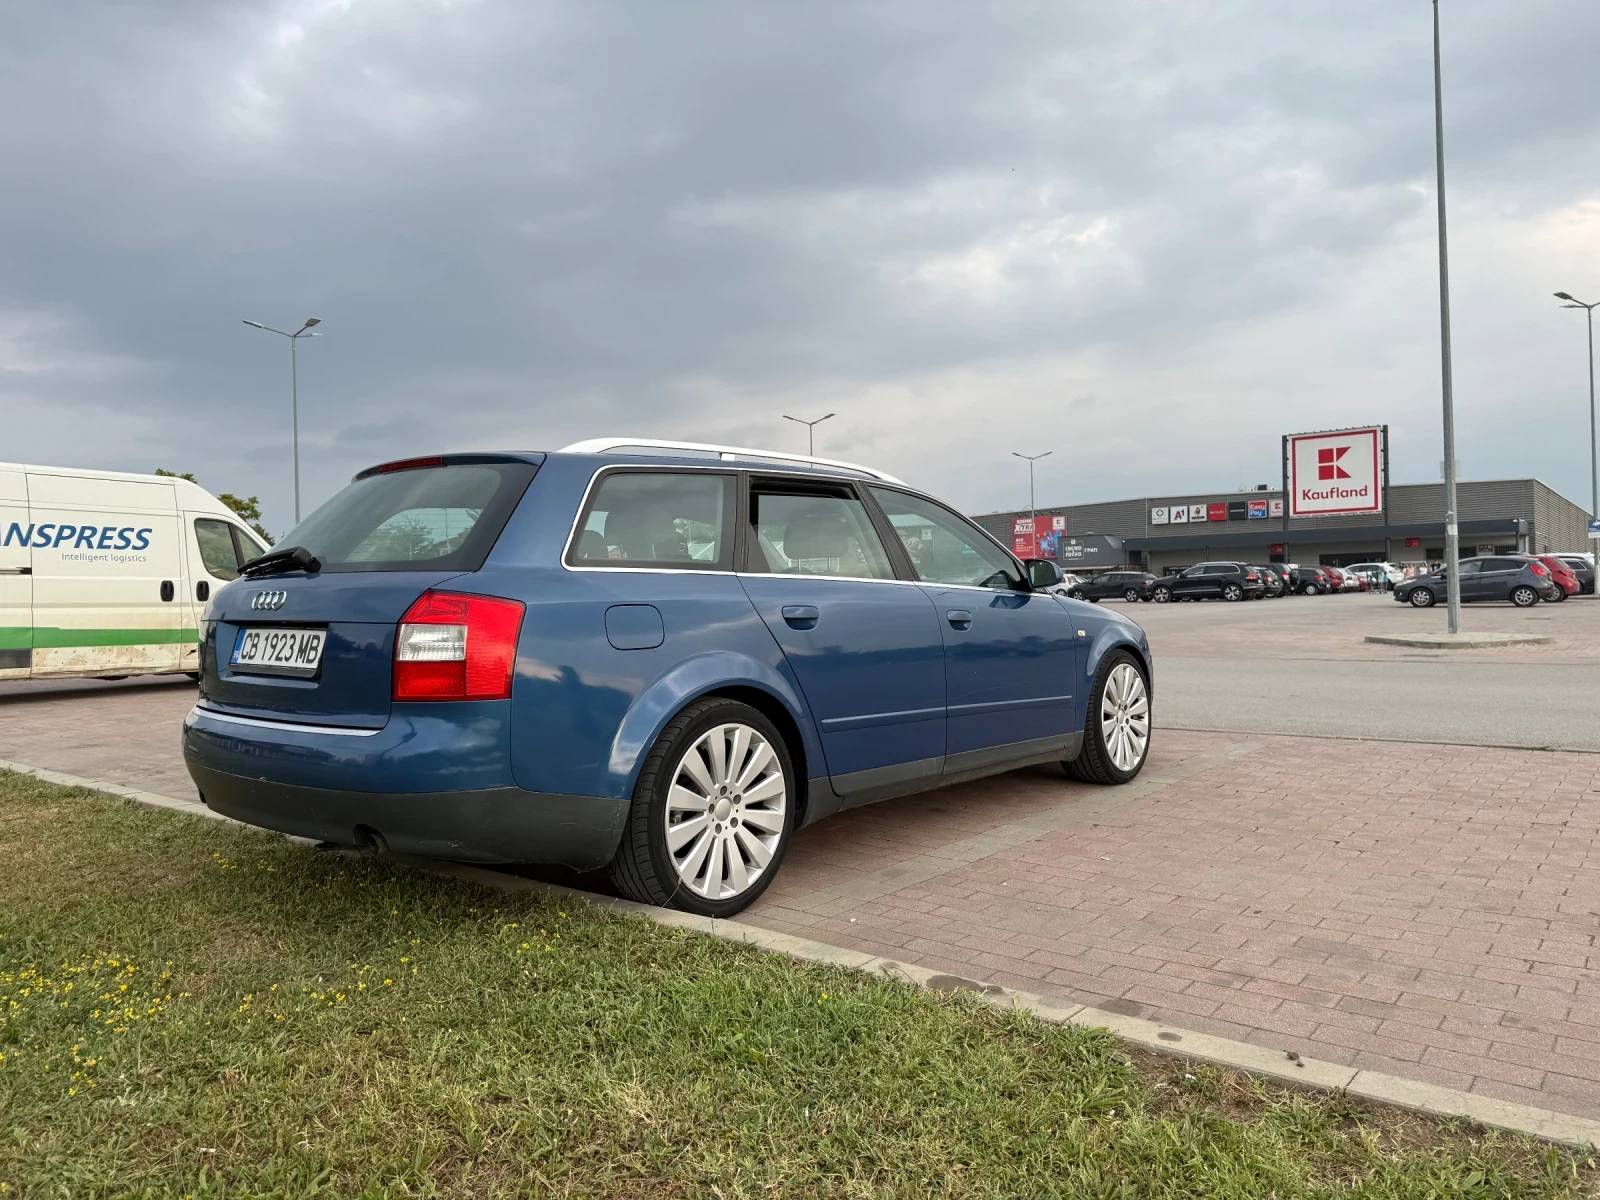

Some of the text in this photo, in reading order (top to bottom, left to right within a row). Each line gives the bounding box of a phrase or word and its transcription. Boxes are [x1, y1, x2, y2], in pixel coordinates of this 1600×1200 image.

[1302, 485, 1368, 500] Kaufland
[1249, 503, 1265, 511] Easy
[1174, 509, 1185, 520] A1
[0, 522, 153, 551] NSPRESS
[61, 552, 147, 564] Intelligent logistics
[241, 632, 321, 664] CB 1923 MB
